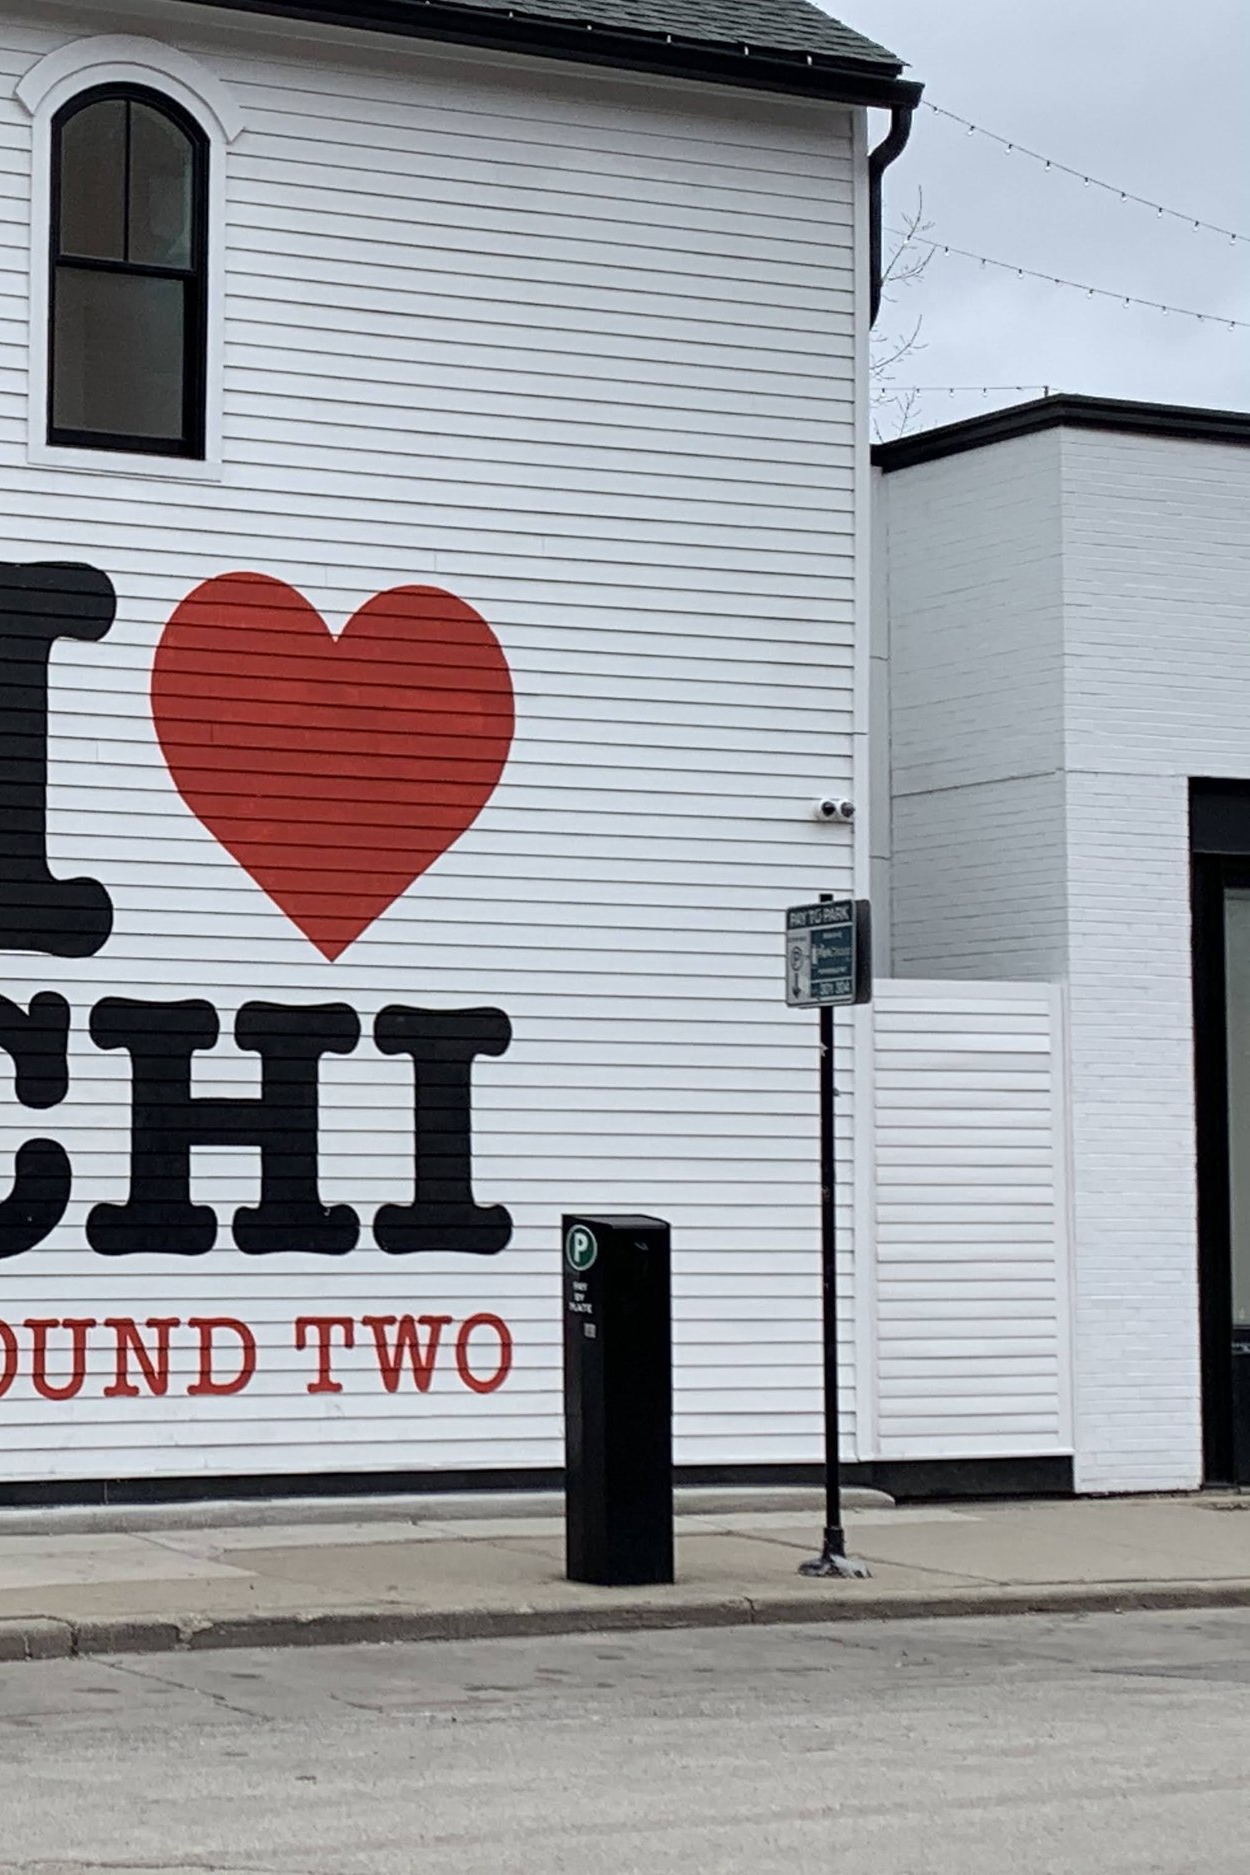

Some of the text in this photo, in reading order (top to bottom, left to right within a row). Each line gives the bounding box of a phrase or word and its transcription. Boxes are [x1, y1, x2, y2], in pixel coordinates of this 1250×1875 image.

[789, 906, 850, 926] PAY TO PARK
[296, 1314, 510, 1392] TWO
